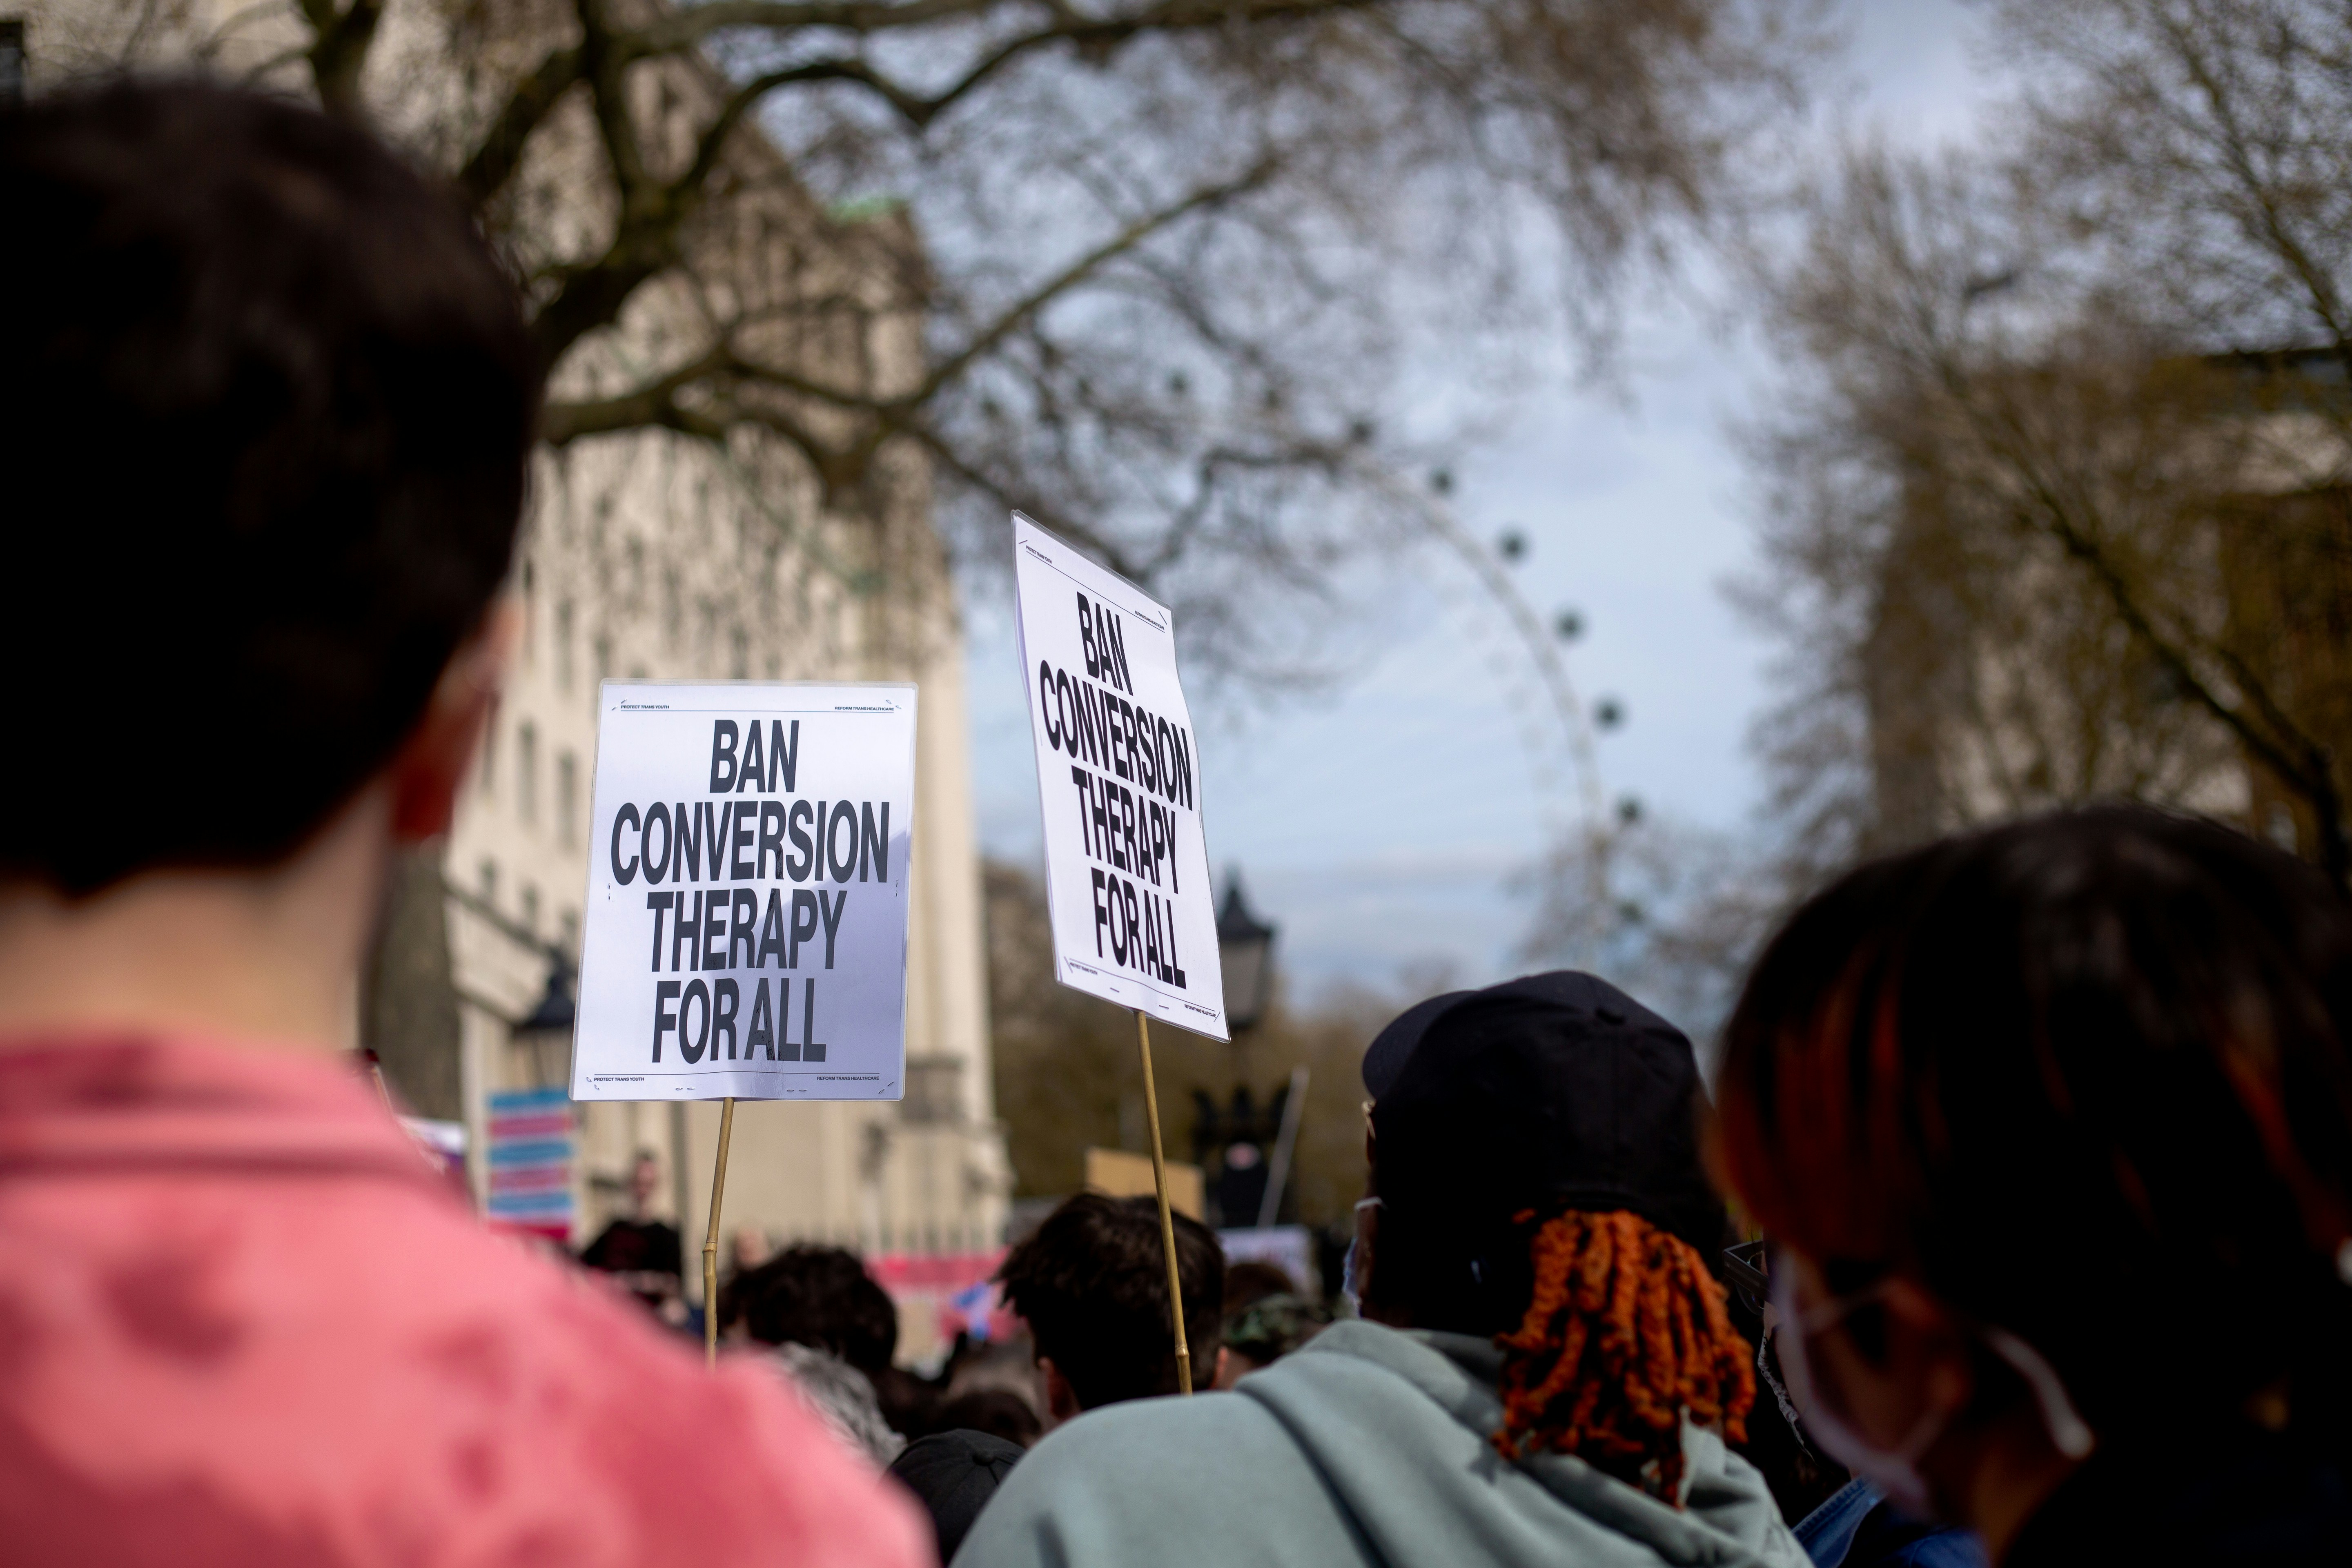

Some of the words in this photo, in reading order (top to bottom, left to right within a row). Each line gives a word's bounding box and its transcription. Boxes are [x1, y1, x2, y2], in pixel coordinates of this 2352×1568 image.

[1077, 592, 1133, 696] BAN
[710, 720, 799, 793] BAN
[1040, 660, 1192, 811] CONVERSION
[611, 800, 889, 885] CONVERSION
[1071, 766, 1178, 894] THERAPY
[647, 889, 847, 972] THERAPY
[1091, 867, 1145, 972] FOR
[1144, 890, 1186, 989] ALL
[653, 978, 739, 1064] FOR
[744, 978, 826, 1062] ALL
